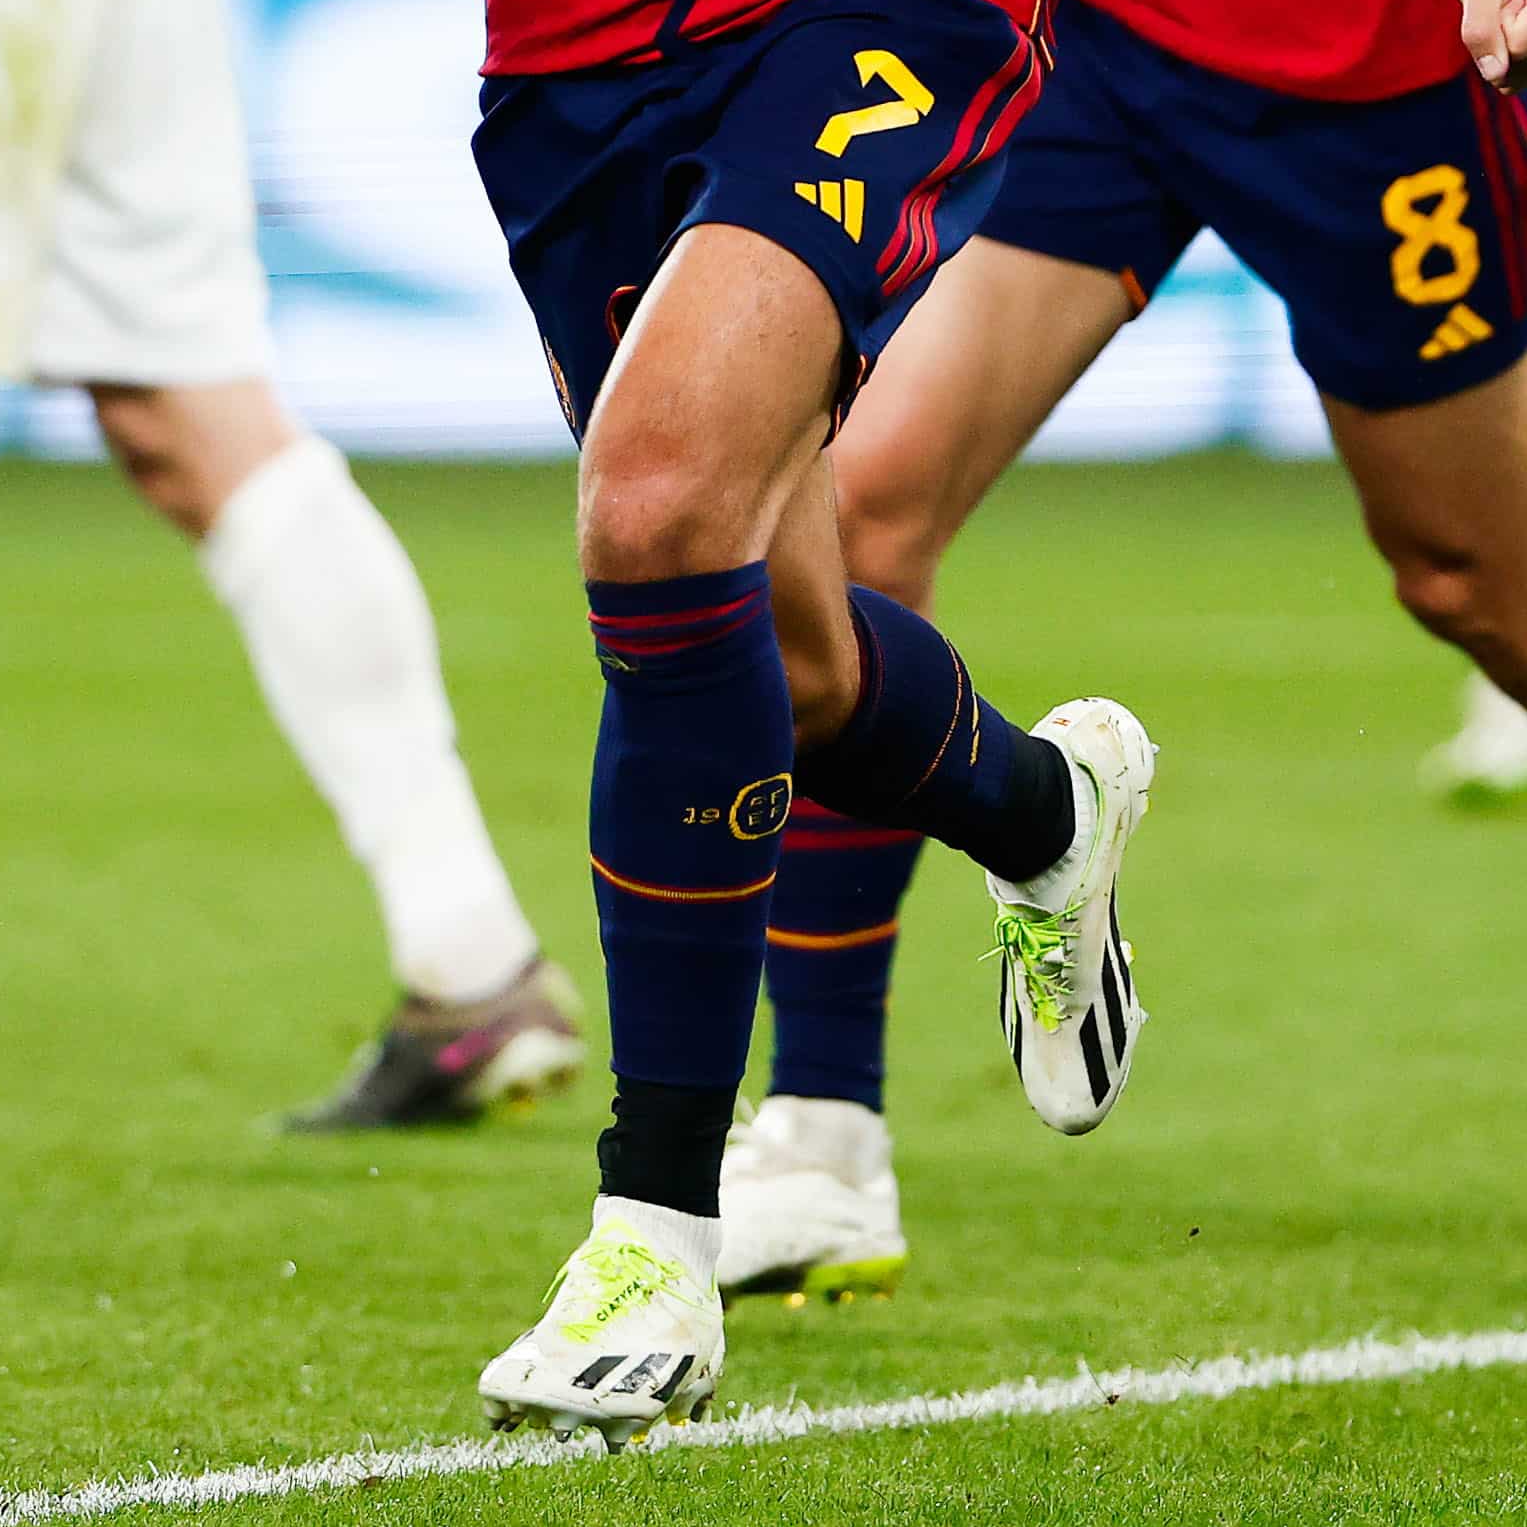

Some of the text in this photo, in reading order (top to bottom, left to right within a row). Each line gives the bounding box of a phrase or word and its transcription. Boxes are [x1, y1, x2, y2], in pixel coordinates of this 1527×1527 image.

[814, 48, 936, 159] 7
[1380, 163, 1481, 306] 8
[682, 807, 721, 824] 19
